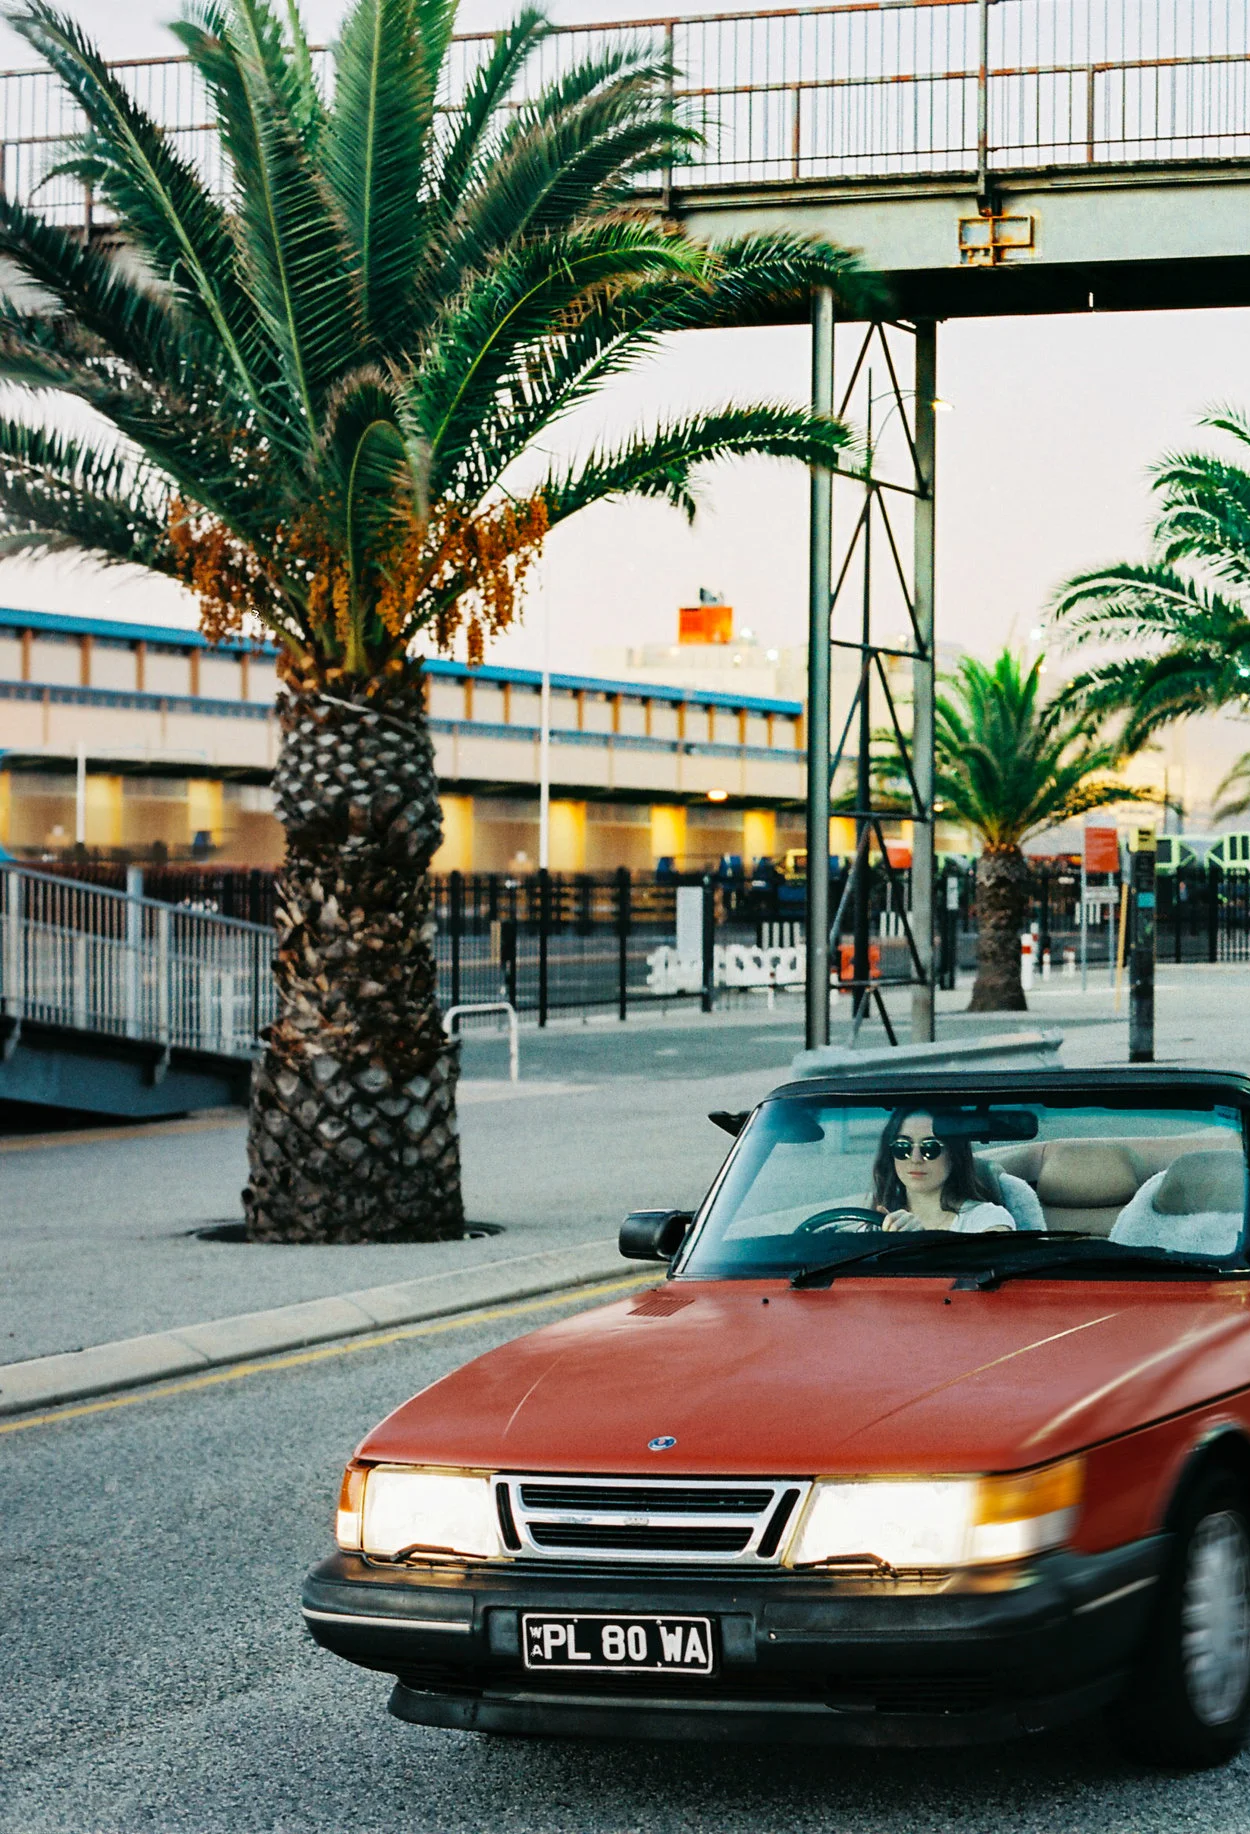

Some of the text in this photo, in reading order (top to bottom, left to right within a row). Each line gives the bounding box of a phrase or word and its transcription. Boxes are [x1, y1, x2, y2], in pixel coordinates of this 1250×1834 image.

[529, 1626, 543, 1657] WA
[543, 1624, 707, 1664] PL 80 WA
